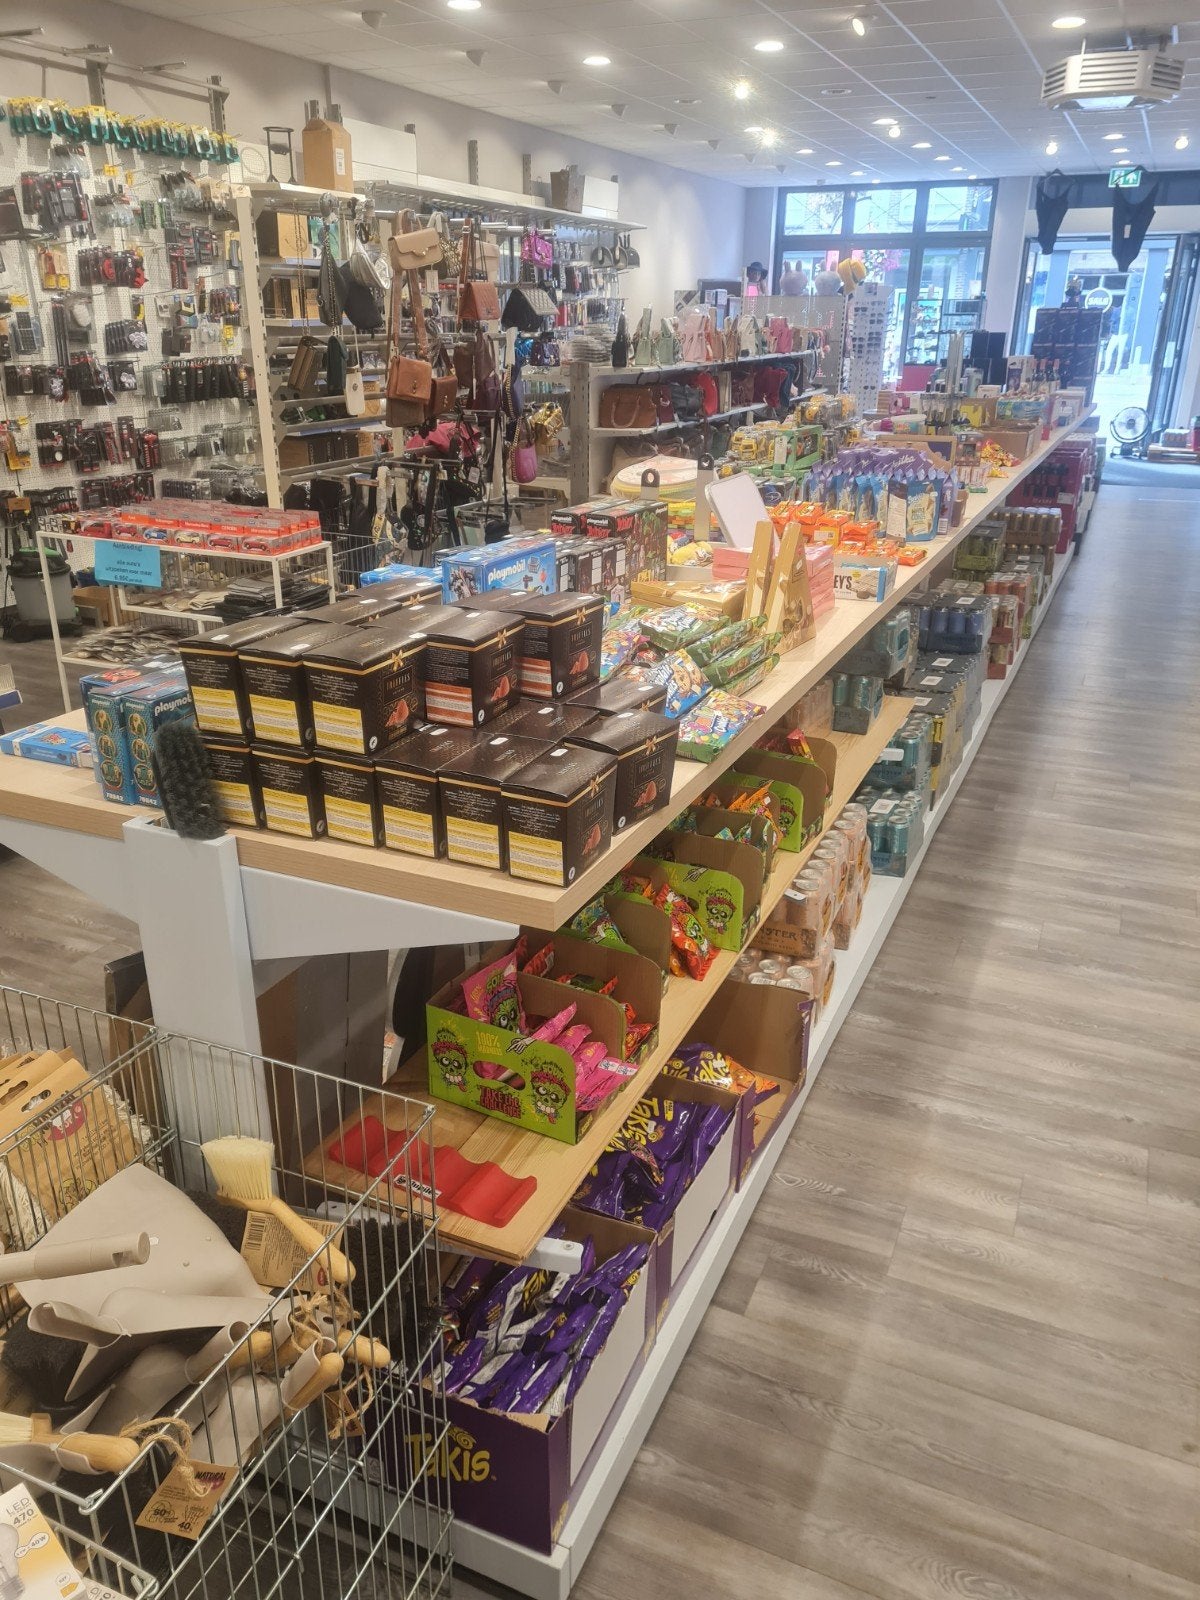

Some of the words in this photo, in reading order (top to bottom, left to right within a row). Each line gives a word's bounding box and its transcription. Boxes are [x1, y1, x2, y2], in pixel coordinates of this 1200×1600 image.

[488, 558, 527, 585] playmobil
[405, 1432, 491, 1482] Takis
[6, 1497, 31, 1516] LED
[13, 1508, 34, 1526] 470
